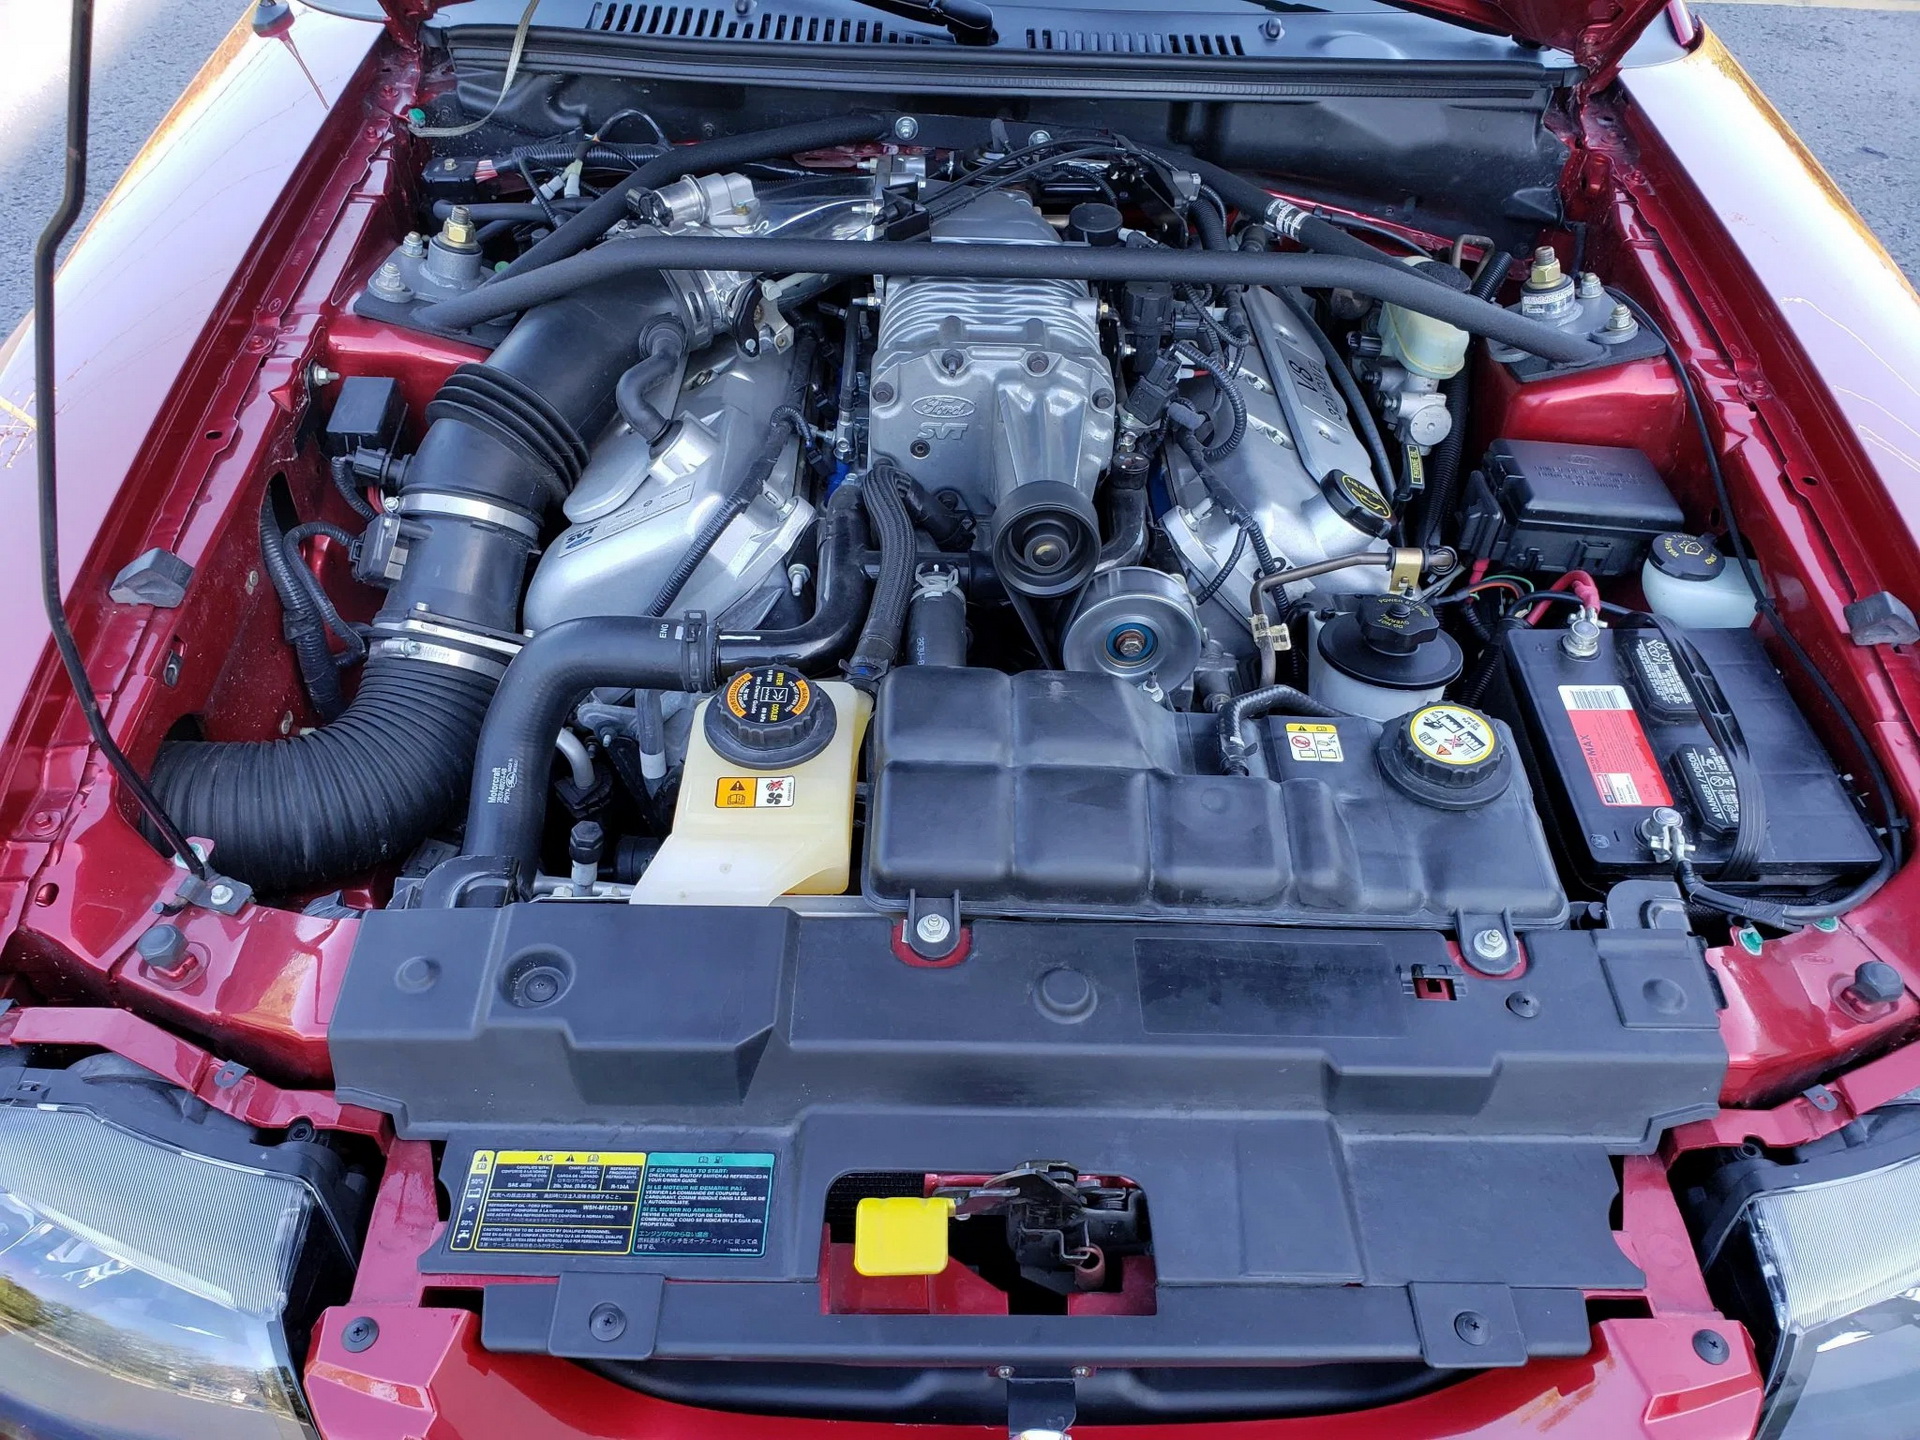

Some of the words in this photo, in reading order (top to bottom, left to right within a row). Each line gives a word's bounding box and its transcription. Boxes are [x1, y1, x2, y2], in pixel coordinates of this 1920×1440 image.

[1288, 360, 1318, 392] V8
[917, 396, 969, 416] Ford
[917, 422, 968, 440] SVT
[659, 623, 669, 639] ENG
[776, 672, 784, 686] INTER
[730, 677, 746, 715] AVERTISSEMENT
[770, 704, 780, 721] COOLER
[1580, 734, 1596, 756] MAX
[1686, 752, 1704, 778] POISON
[488, 767, 501, 804] Motorcraft
[1701, 784, 1720, 812] DANGER
